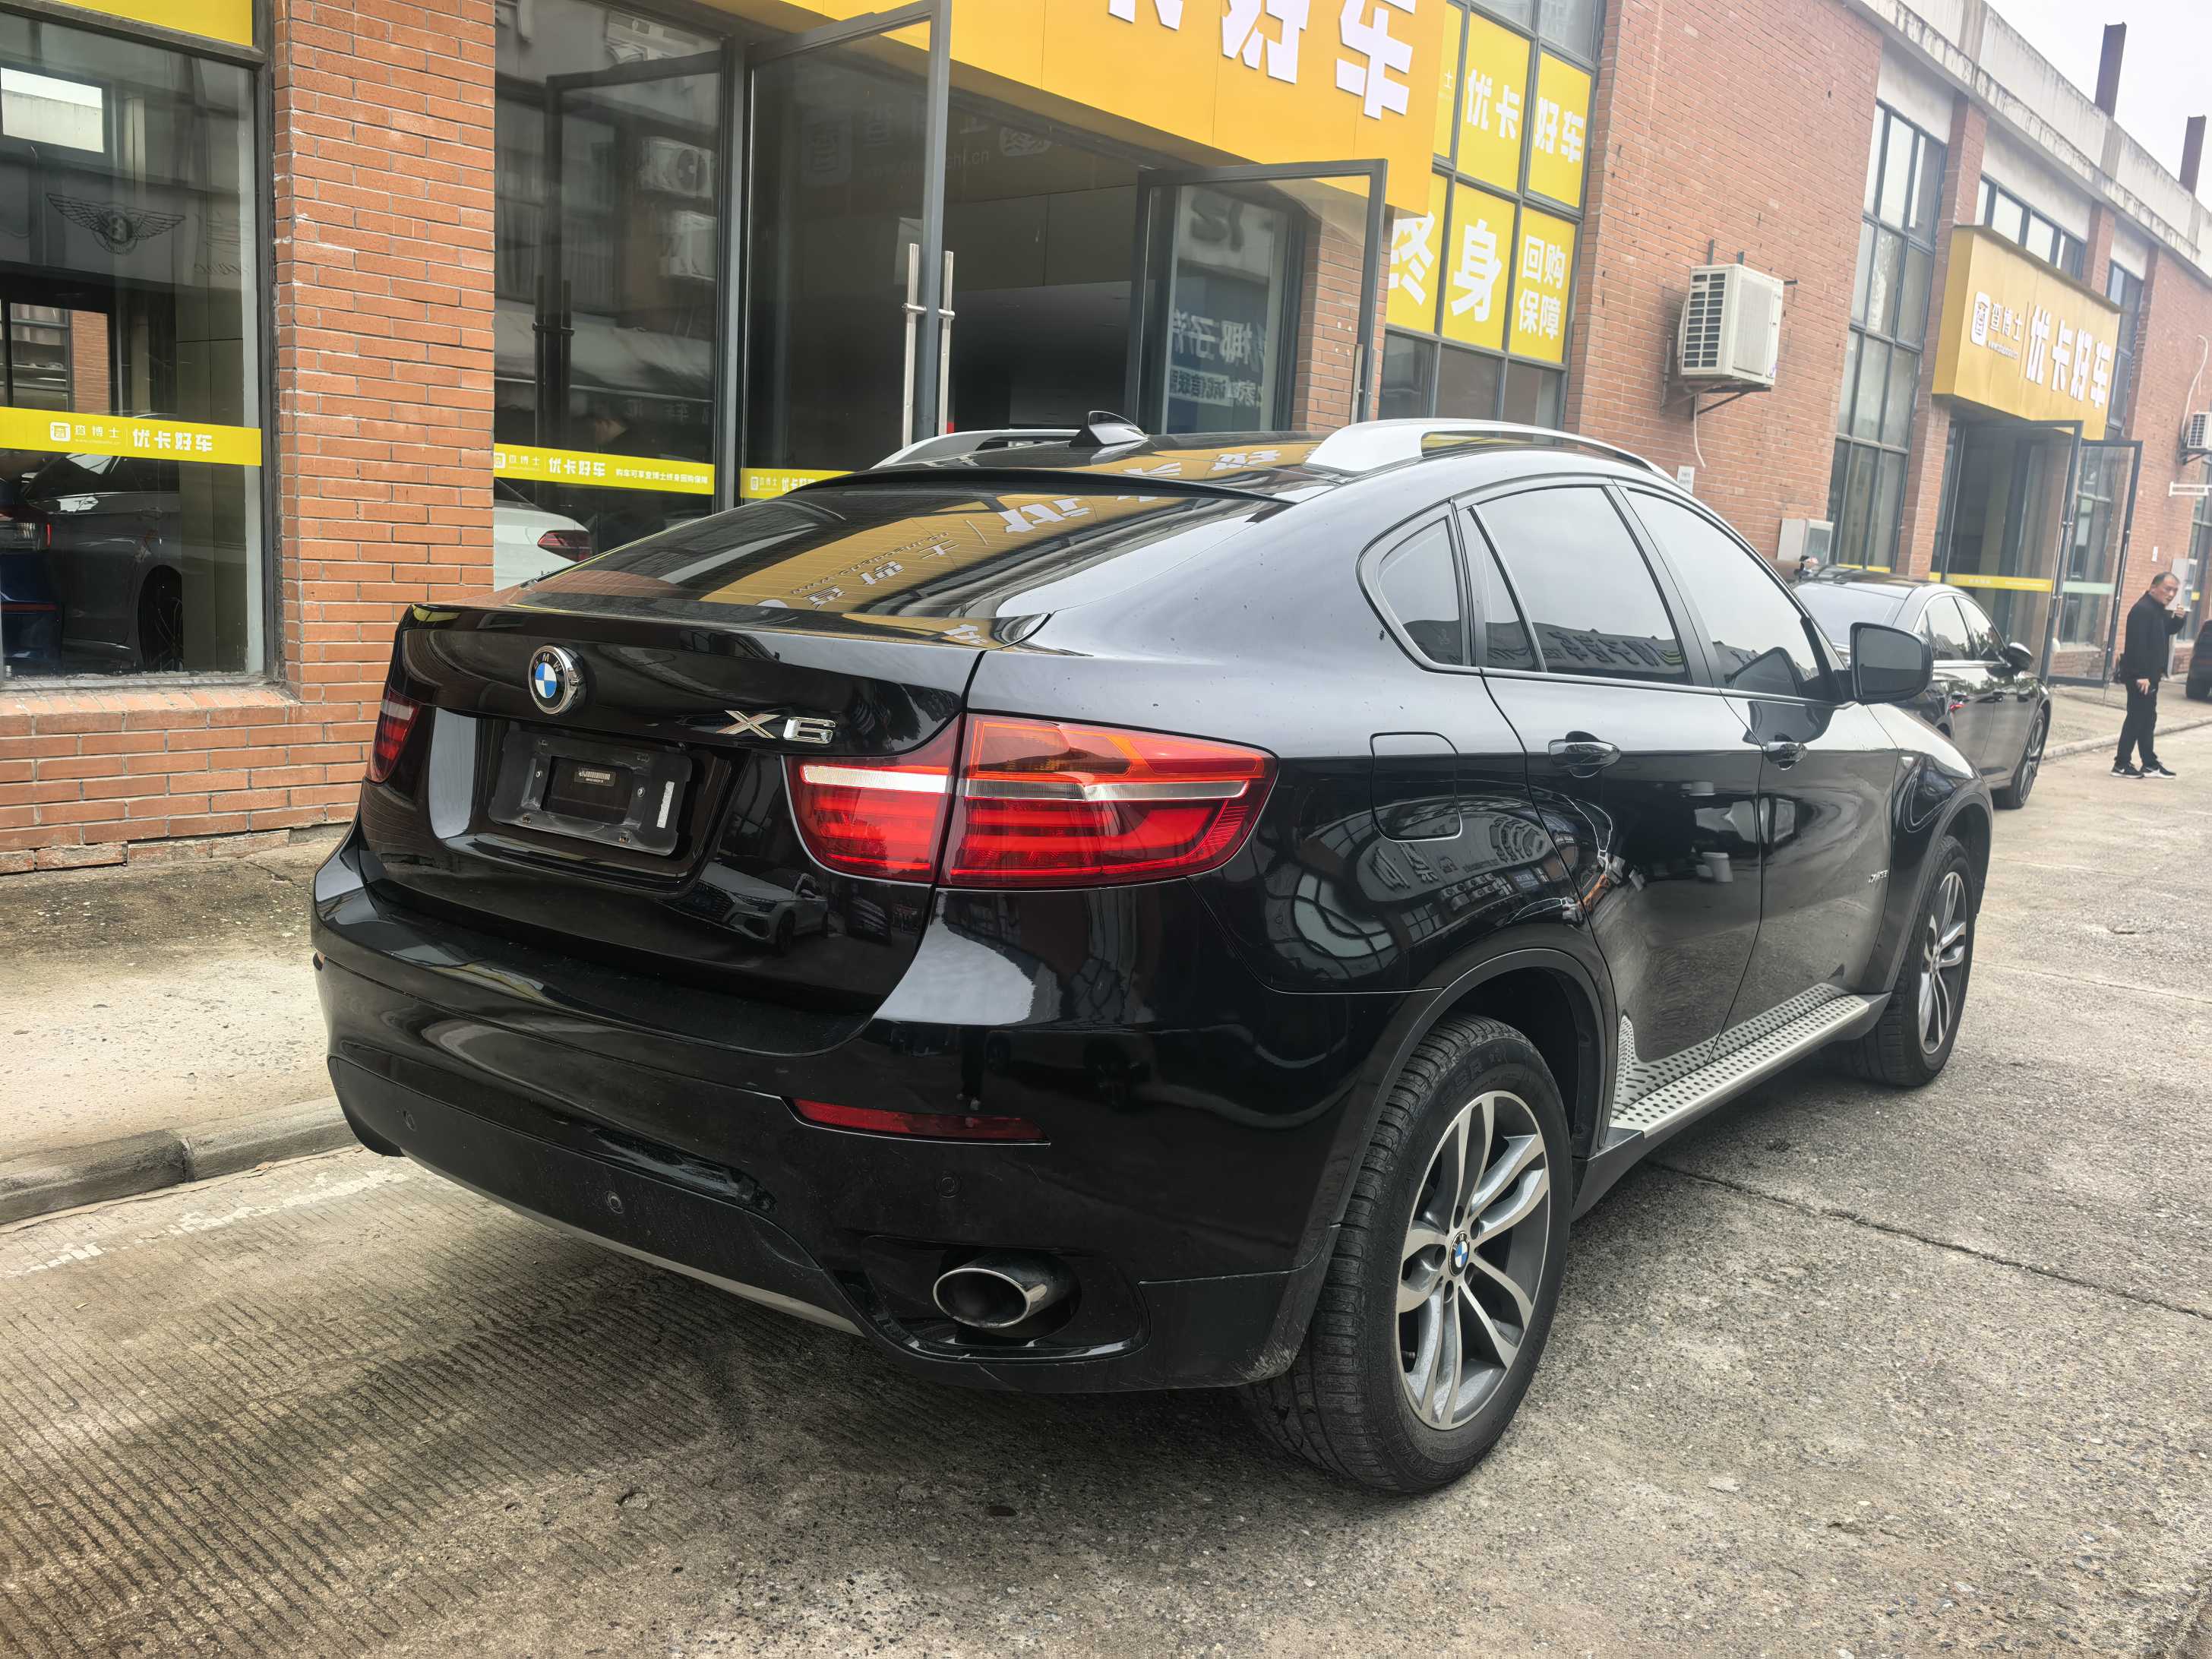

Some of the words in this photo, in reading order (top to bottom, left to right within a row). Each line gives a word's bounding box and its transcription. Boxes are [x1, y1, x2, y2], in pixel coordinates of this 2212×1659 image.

[1108, 0, 1417, 121] 好车
[1522, 234, 1566, 289] 回购
[1519, 289, 1562, 340] 保障
[2026, 305, 2112, 409] 优卡好车
[132, 428, 213, 452] 优卡好车
[548, 457, 605, 477] 优卡好车
[533, 652, 563, 672] BMW
[716, 709, 836, 744] X6
